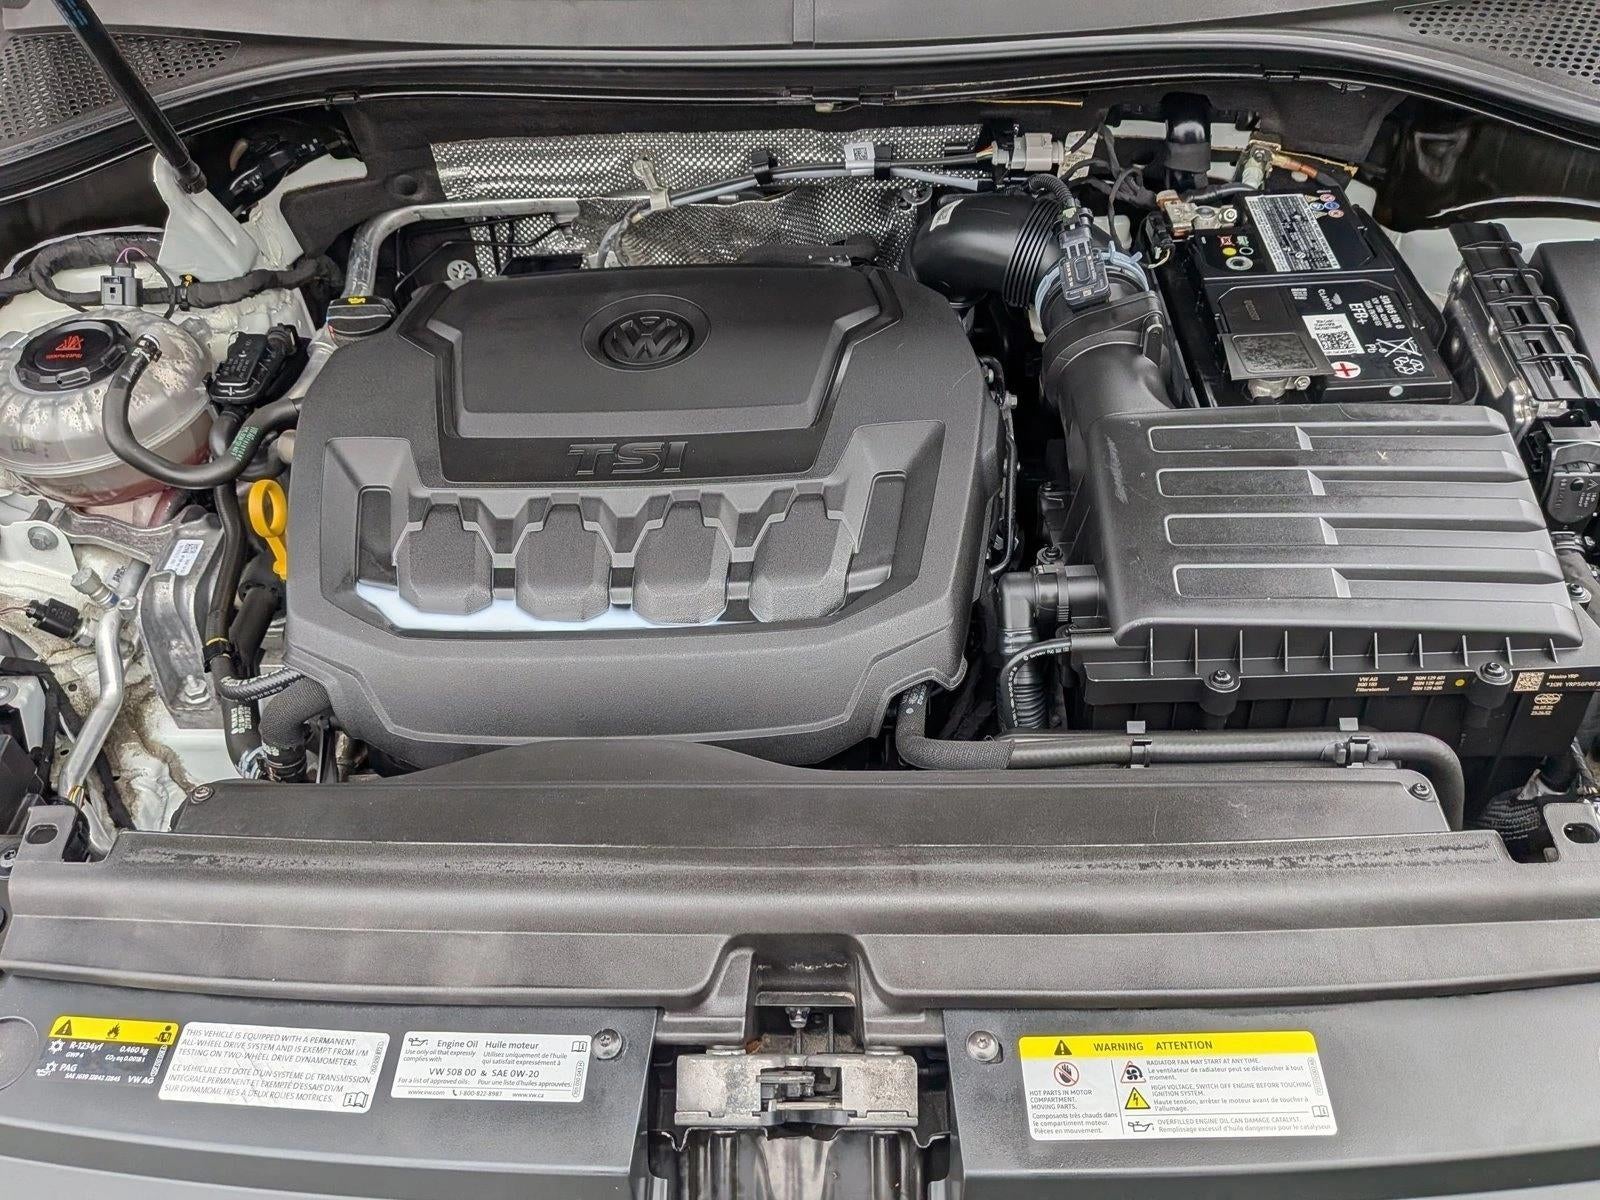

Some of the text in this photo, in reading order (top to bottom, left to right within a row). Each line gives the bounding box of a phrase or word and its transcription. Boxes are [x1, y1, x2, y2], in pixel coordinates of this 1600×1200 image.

[1348, 303, 1369, 324] EFB+
[567, 441, 688, 475] TSI
[242, 1032, 279, 1041] EQUIPPED
[309, 1036, 356, 1046] PERMANENT
[436, 1040, 465, 1048] Engine
[70, 1041, 104, 1052] R-1234yf
[140, 1047, 150, 1055] kg
[181, 1038, 222, 1047] ALL-WHEEL
[302, 1046, 332, 1054] EXEMPT
[1093, 1041, 1213, 1051] WARNING ATTENTION
[177, 1048, 208, 1056] TESTING
[222, 1051, 270, 1060] TWO-WHEEL
[59, 1064, 78, 1072] PAG
[206, 1076, 250, 1086] PERMANENT
[316, 1073, 371, 1084] TRANSMISSION
[247, 1089, 268, 1097] DEUX
[269, 1091, 294, 1099] ROUES
